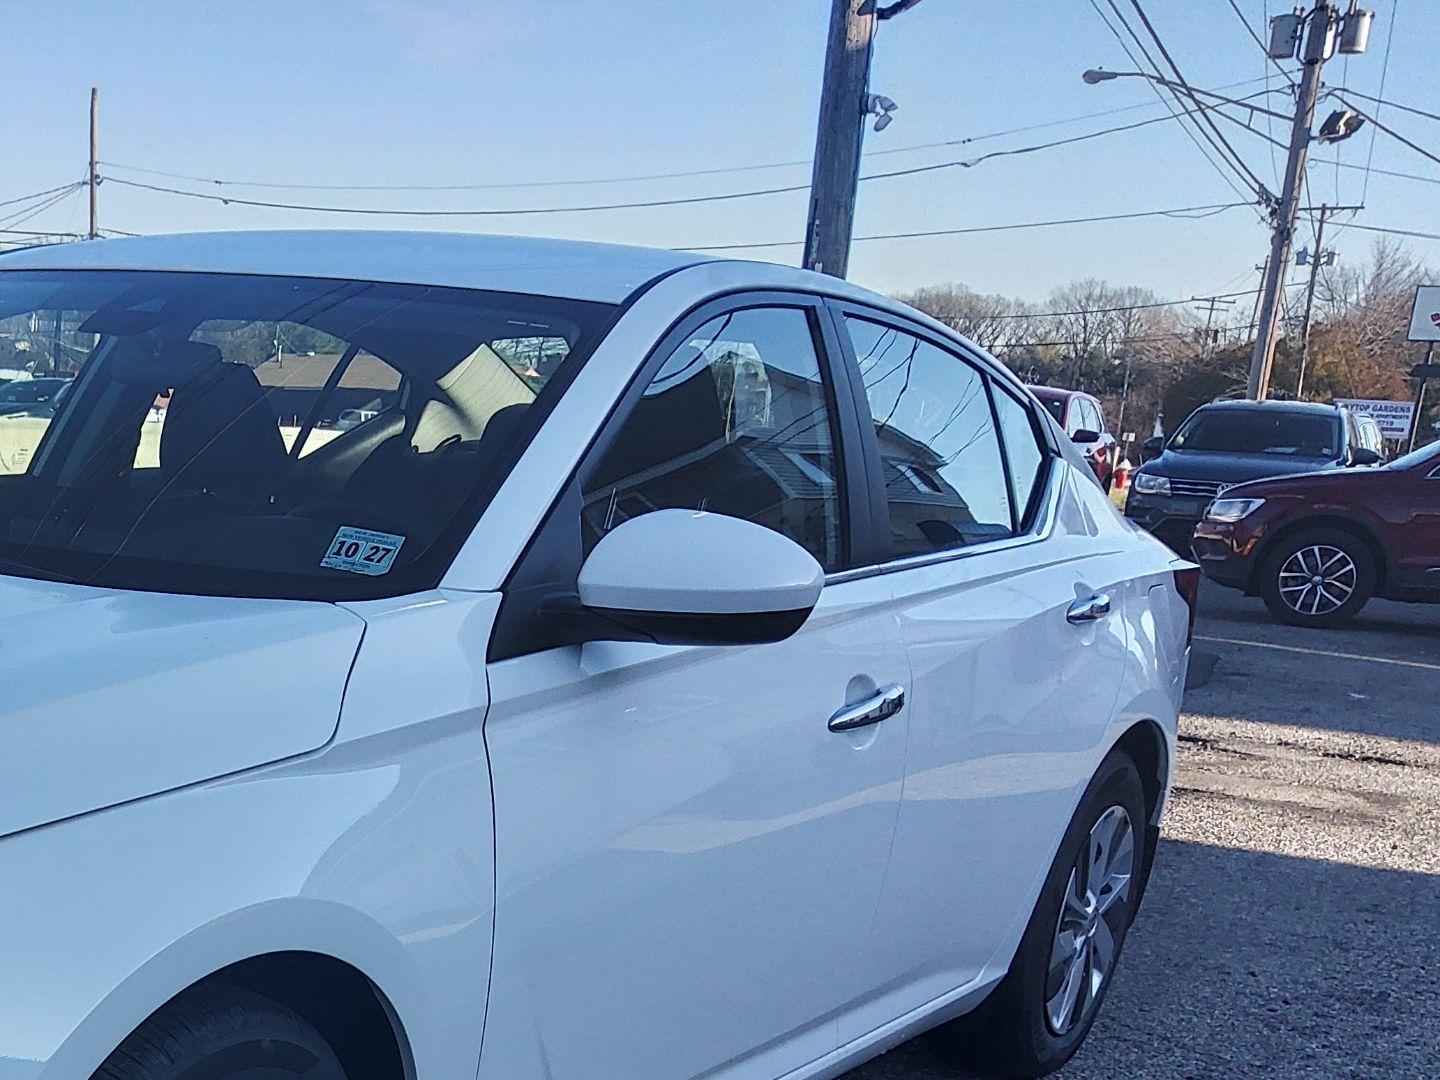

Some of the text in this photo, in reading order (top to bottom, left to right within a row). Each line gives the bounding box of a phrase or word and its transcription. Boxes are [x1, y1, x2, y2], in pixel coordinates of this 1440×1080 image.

[1372, 404, 1411, 413] GARDENS
[331, 539, 360, 559] 10
[363, 545, 394, 564] 27
